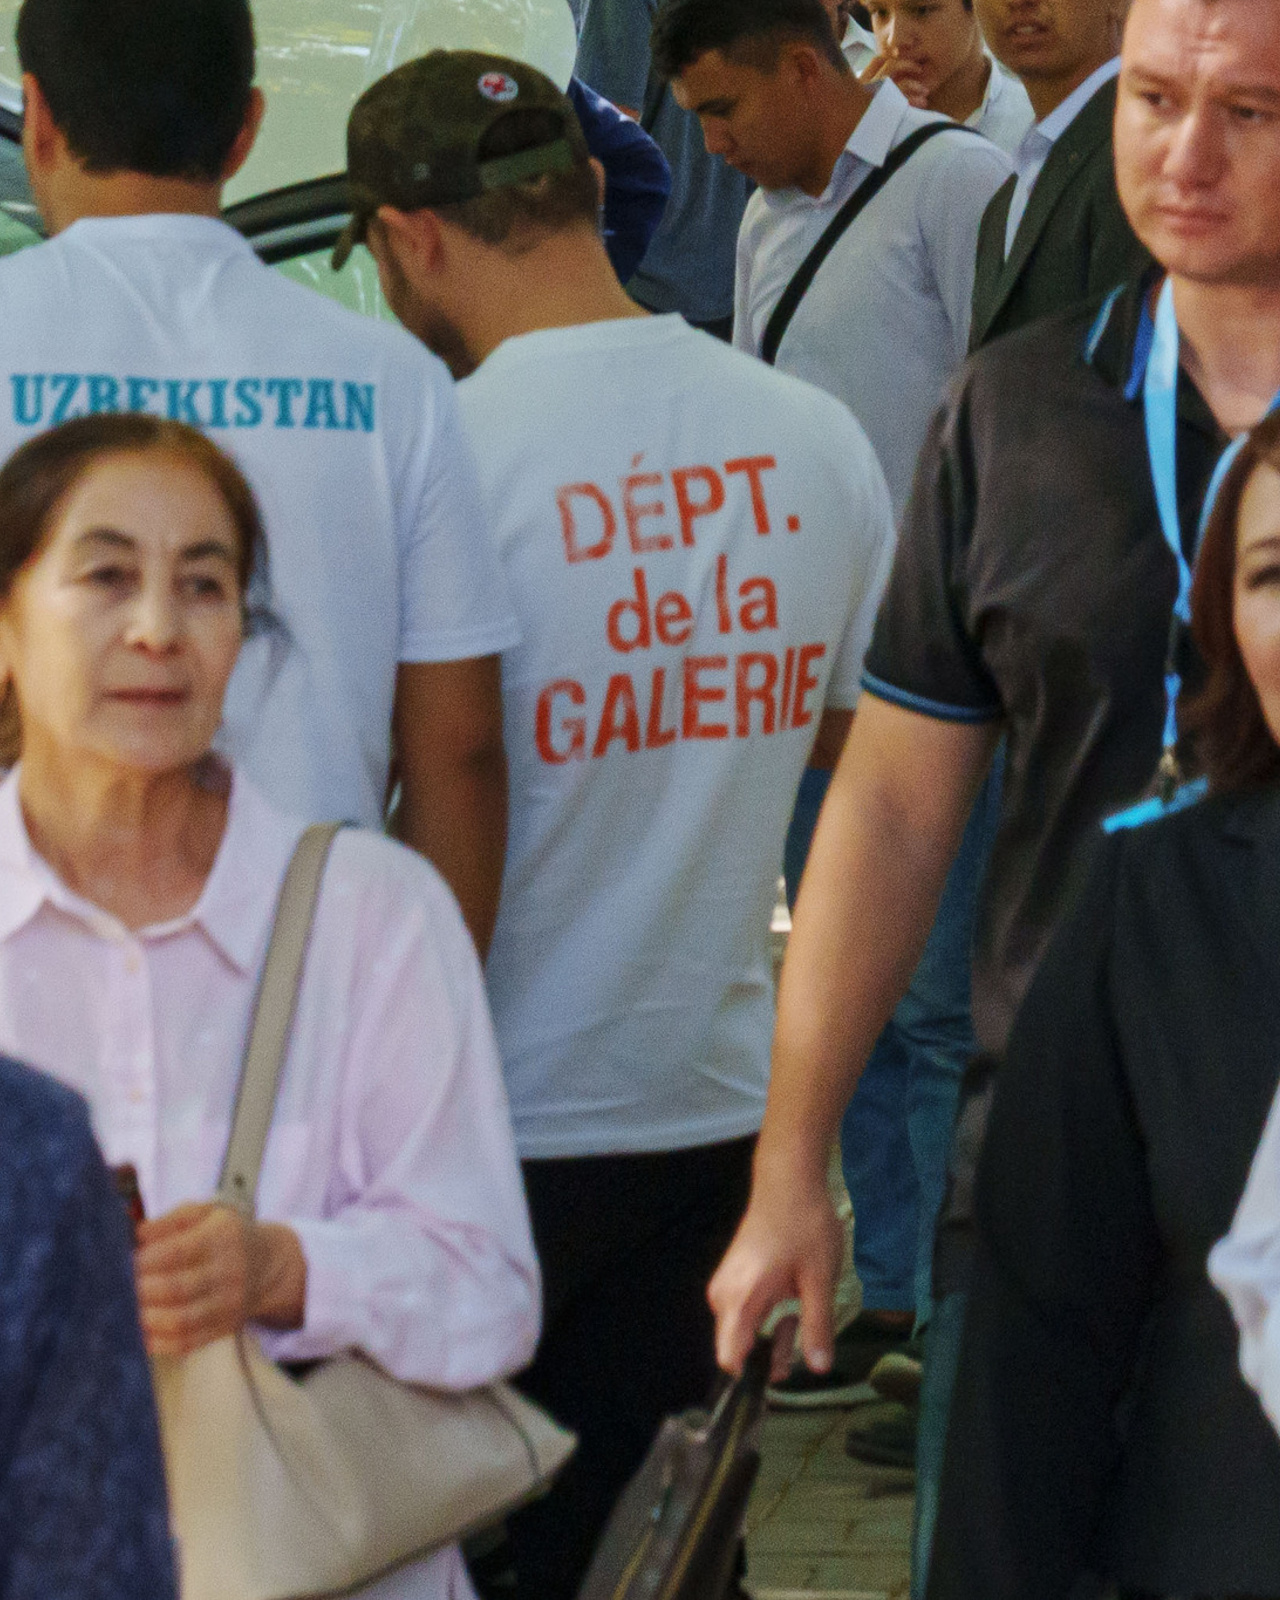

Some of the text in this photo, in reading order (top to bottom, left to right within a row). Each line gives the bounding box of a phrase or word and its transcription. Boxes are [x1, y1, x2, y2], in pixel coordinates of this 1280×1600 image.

[10, 373, 375, 433] UZBEKISTAN
[556, 453, 800, 564] DÉPT.
[606, 554, 778, 654] de la
[534, 643, 826, 765] GALERIE
